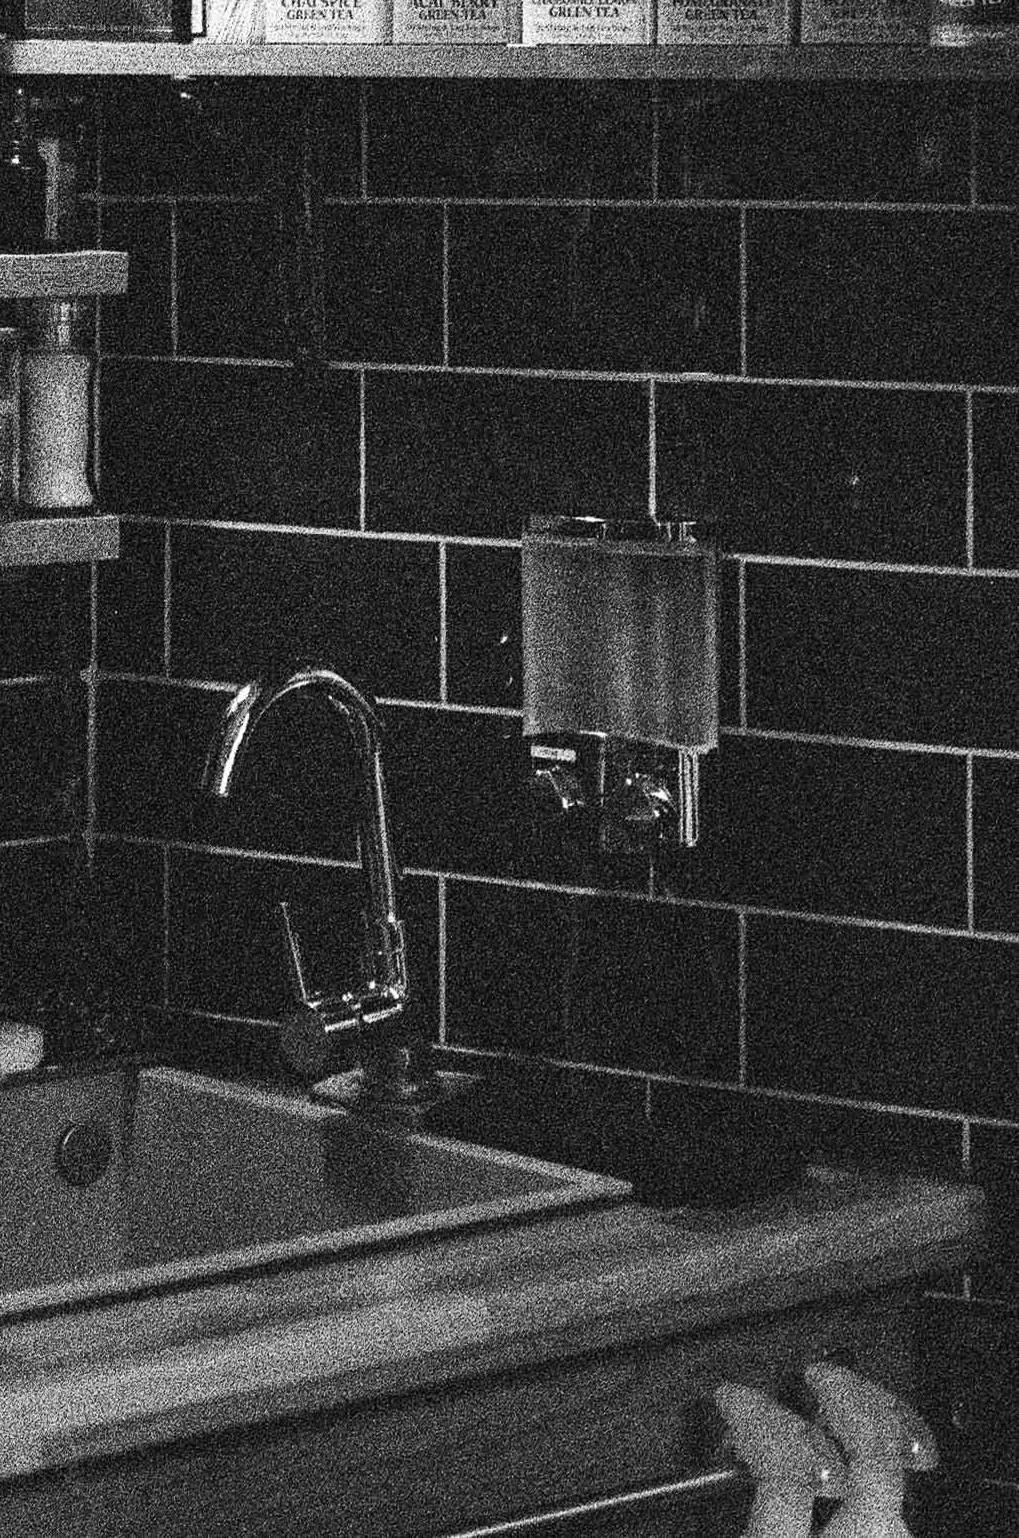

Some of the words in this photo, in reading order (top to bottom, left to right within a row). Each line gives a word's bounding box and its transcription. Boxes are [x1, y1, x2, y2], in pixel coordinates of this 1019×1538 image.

[285, 9, 327, 21] GREEN
[329, 9, 355, 20] TEA
[417, 9, 460, 21] GREEN
[463, 9, 488, 20] TEA
[548, 6, 592, 19] GREEN
[595, 6, 621, 18] TEA
